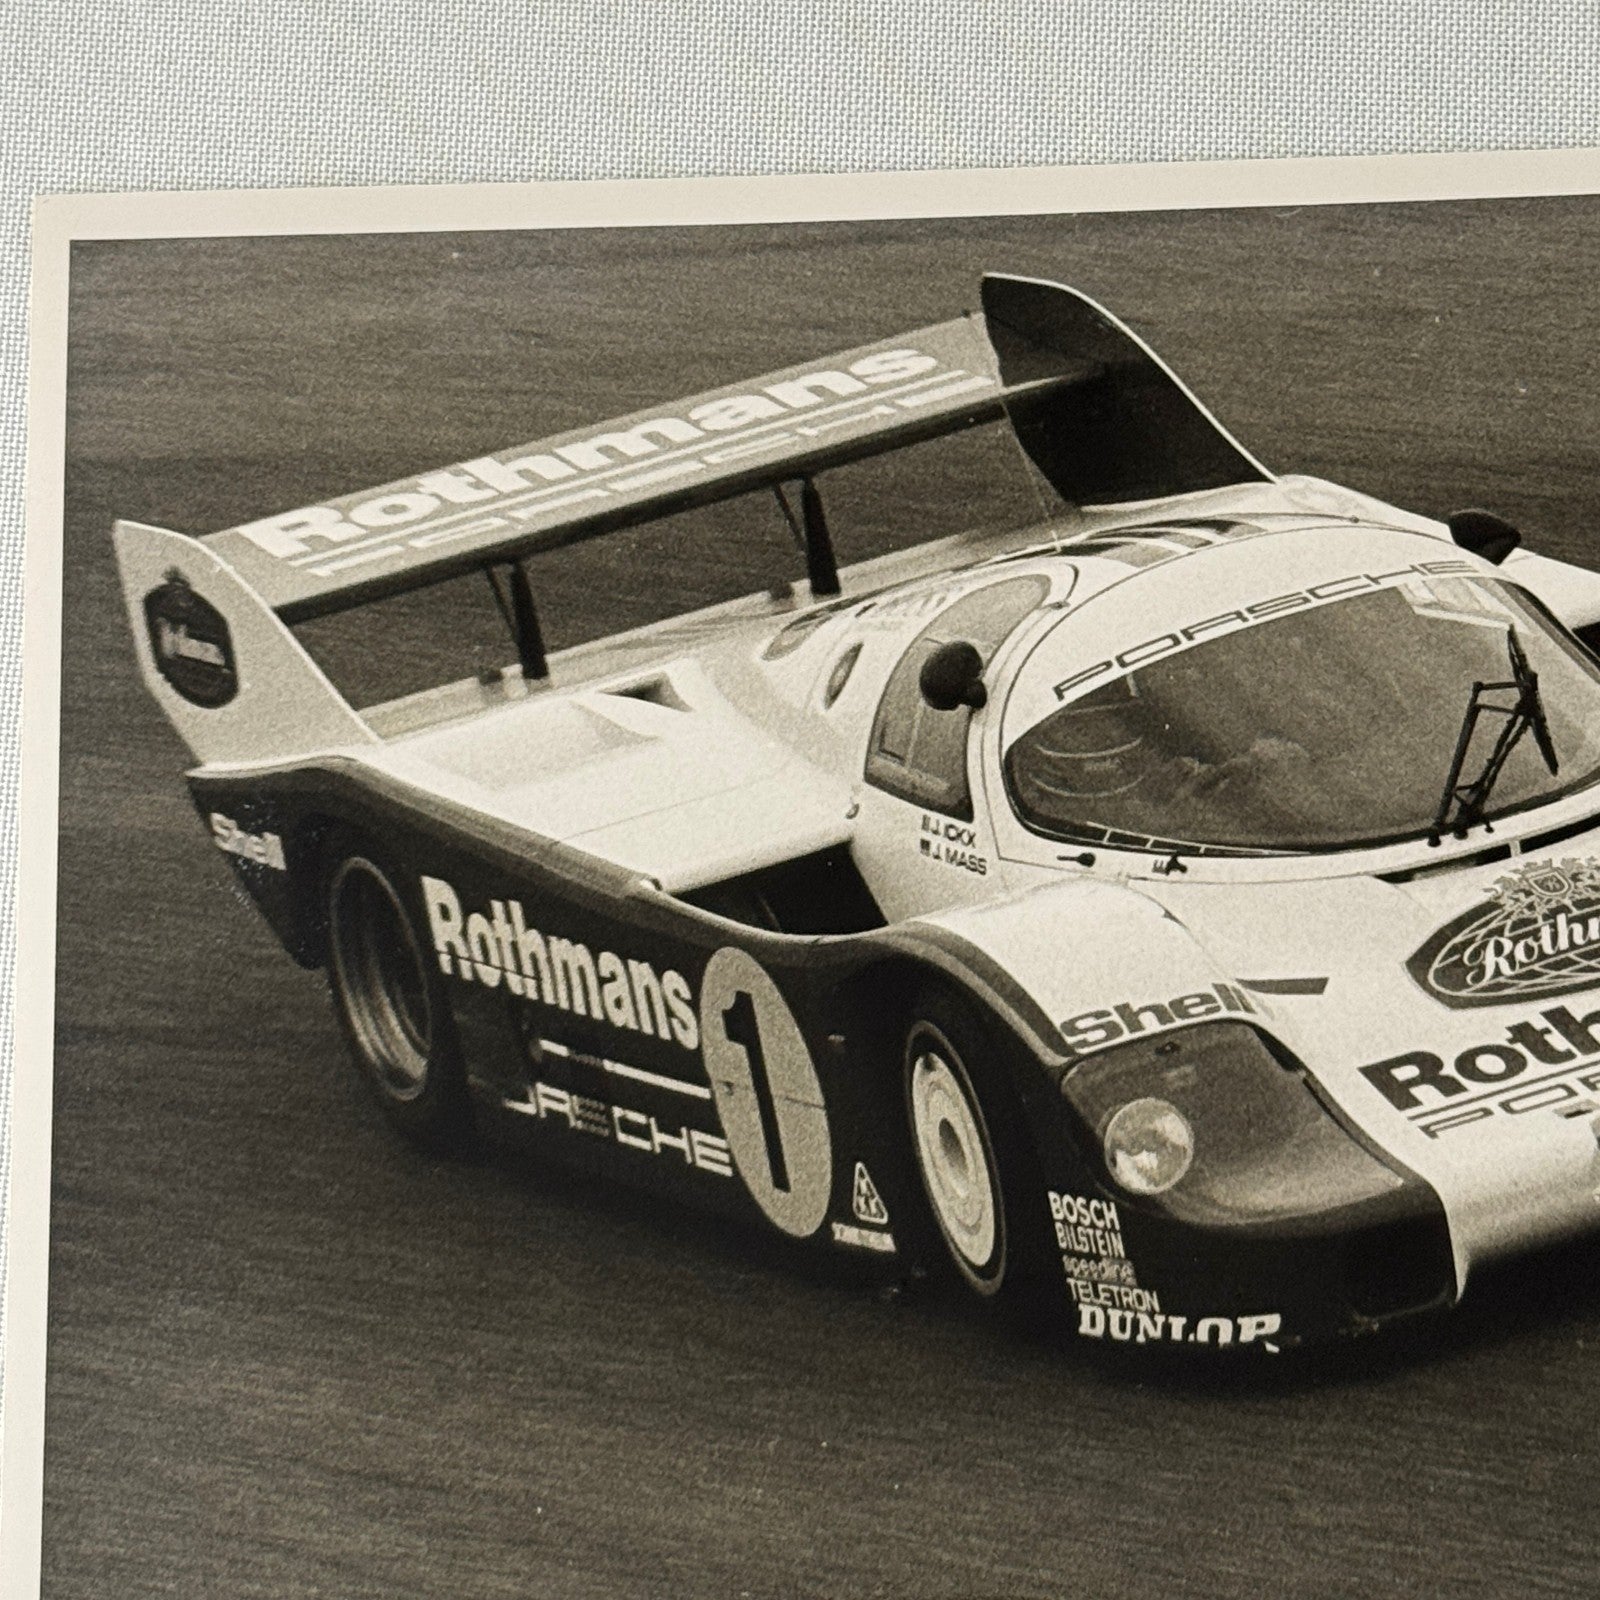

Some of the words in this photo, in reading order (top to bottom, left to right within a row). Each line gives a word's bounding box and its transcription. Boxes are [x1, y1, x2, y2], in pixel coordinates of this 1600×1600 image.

[238, 348, 937, 559] Rothmans
[1053, 559, 1480, 702] PORSCHE
[420, 875, 699, 1050] Rothmans
[1059, 981, 1257, 1049] Shell
[722, 989, 792, 1194] 1
[1048, 1191, 1121, 1231] BOSCH
[1055, 1222, 1126, 1259] BILSTEIN
[1066, 1277, 1161, 1312] TELETRON
[1078, 1303, 1282, 1353] DUNLOP
